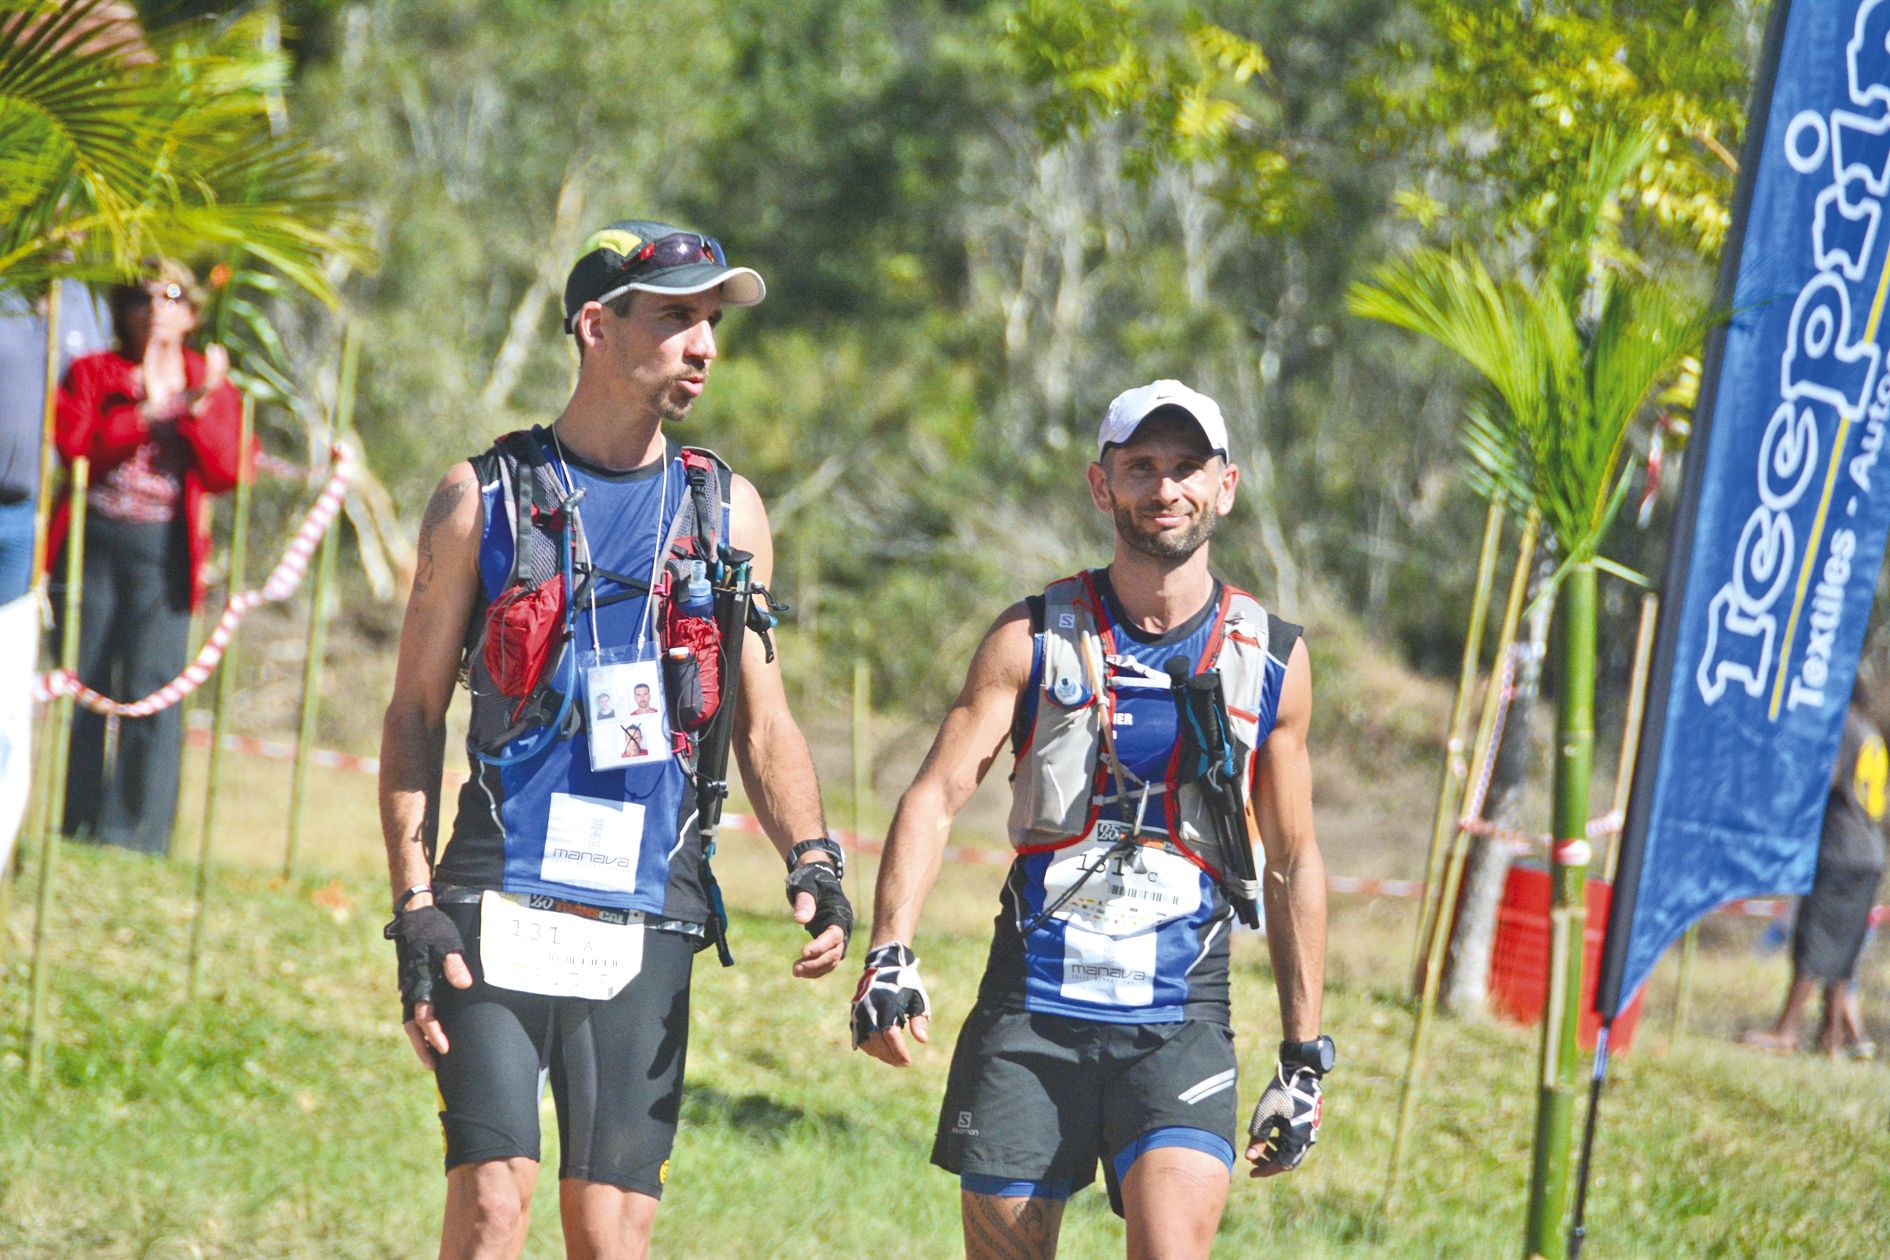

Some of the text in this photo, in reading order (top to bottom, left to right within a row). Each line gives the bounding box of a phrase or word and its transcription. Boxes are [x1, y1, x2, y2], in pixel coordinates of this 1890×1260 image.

[1786, 528, 1857, 711] Textiles
[553, 847, 629, 868] manava
[1071, 964, 1146, 981] manava
